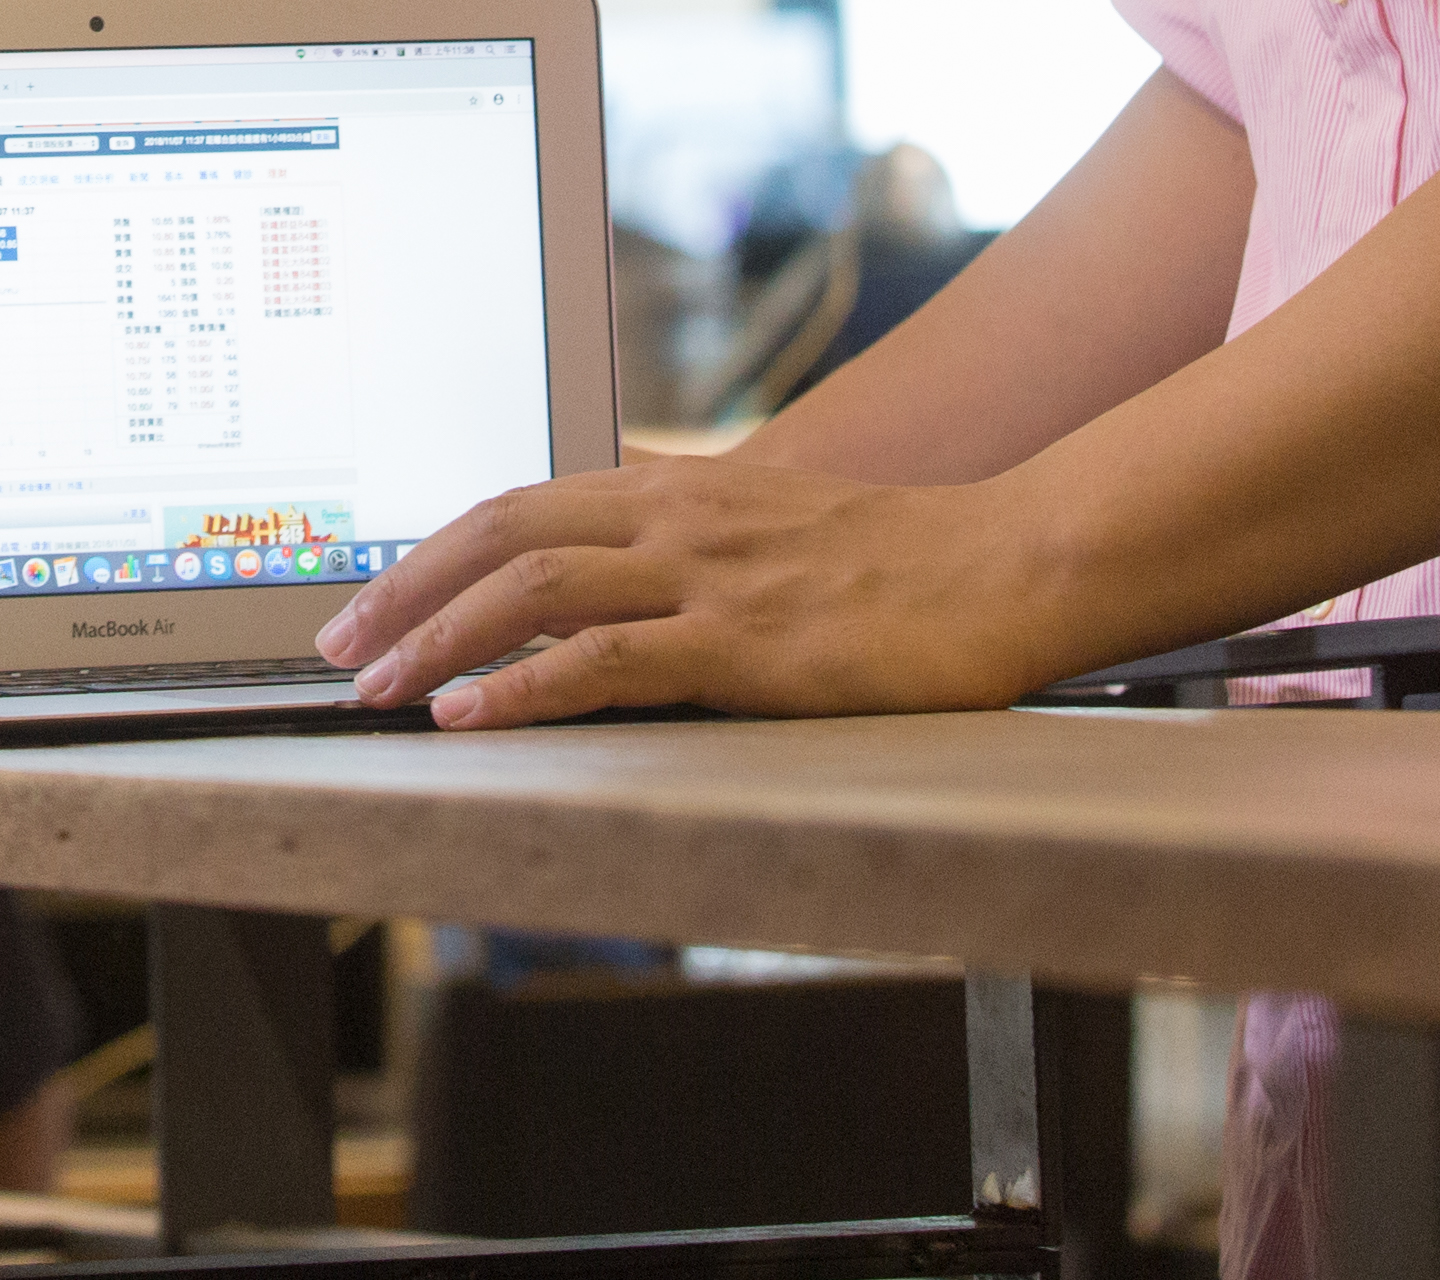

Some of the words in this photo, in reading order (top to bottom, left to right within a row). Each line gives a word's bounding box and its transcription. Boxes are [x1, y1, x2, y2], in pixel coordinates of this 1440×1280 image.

[12, 207, 34, 215] 11:37
[72, 619, 148, 638] MacBook
[154, 619, 175, 635] Air
